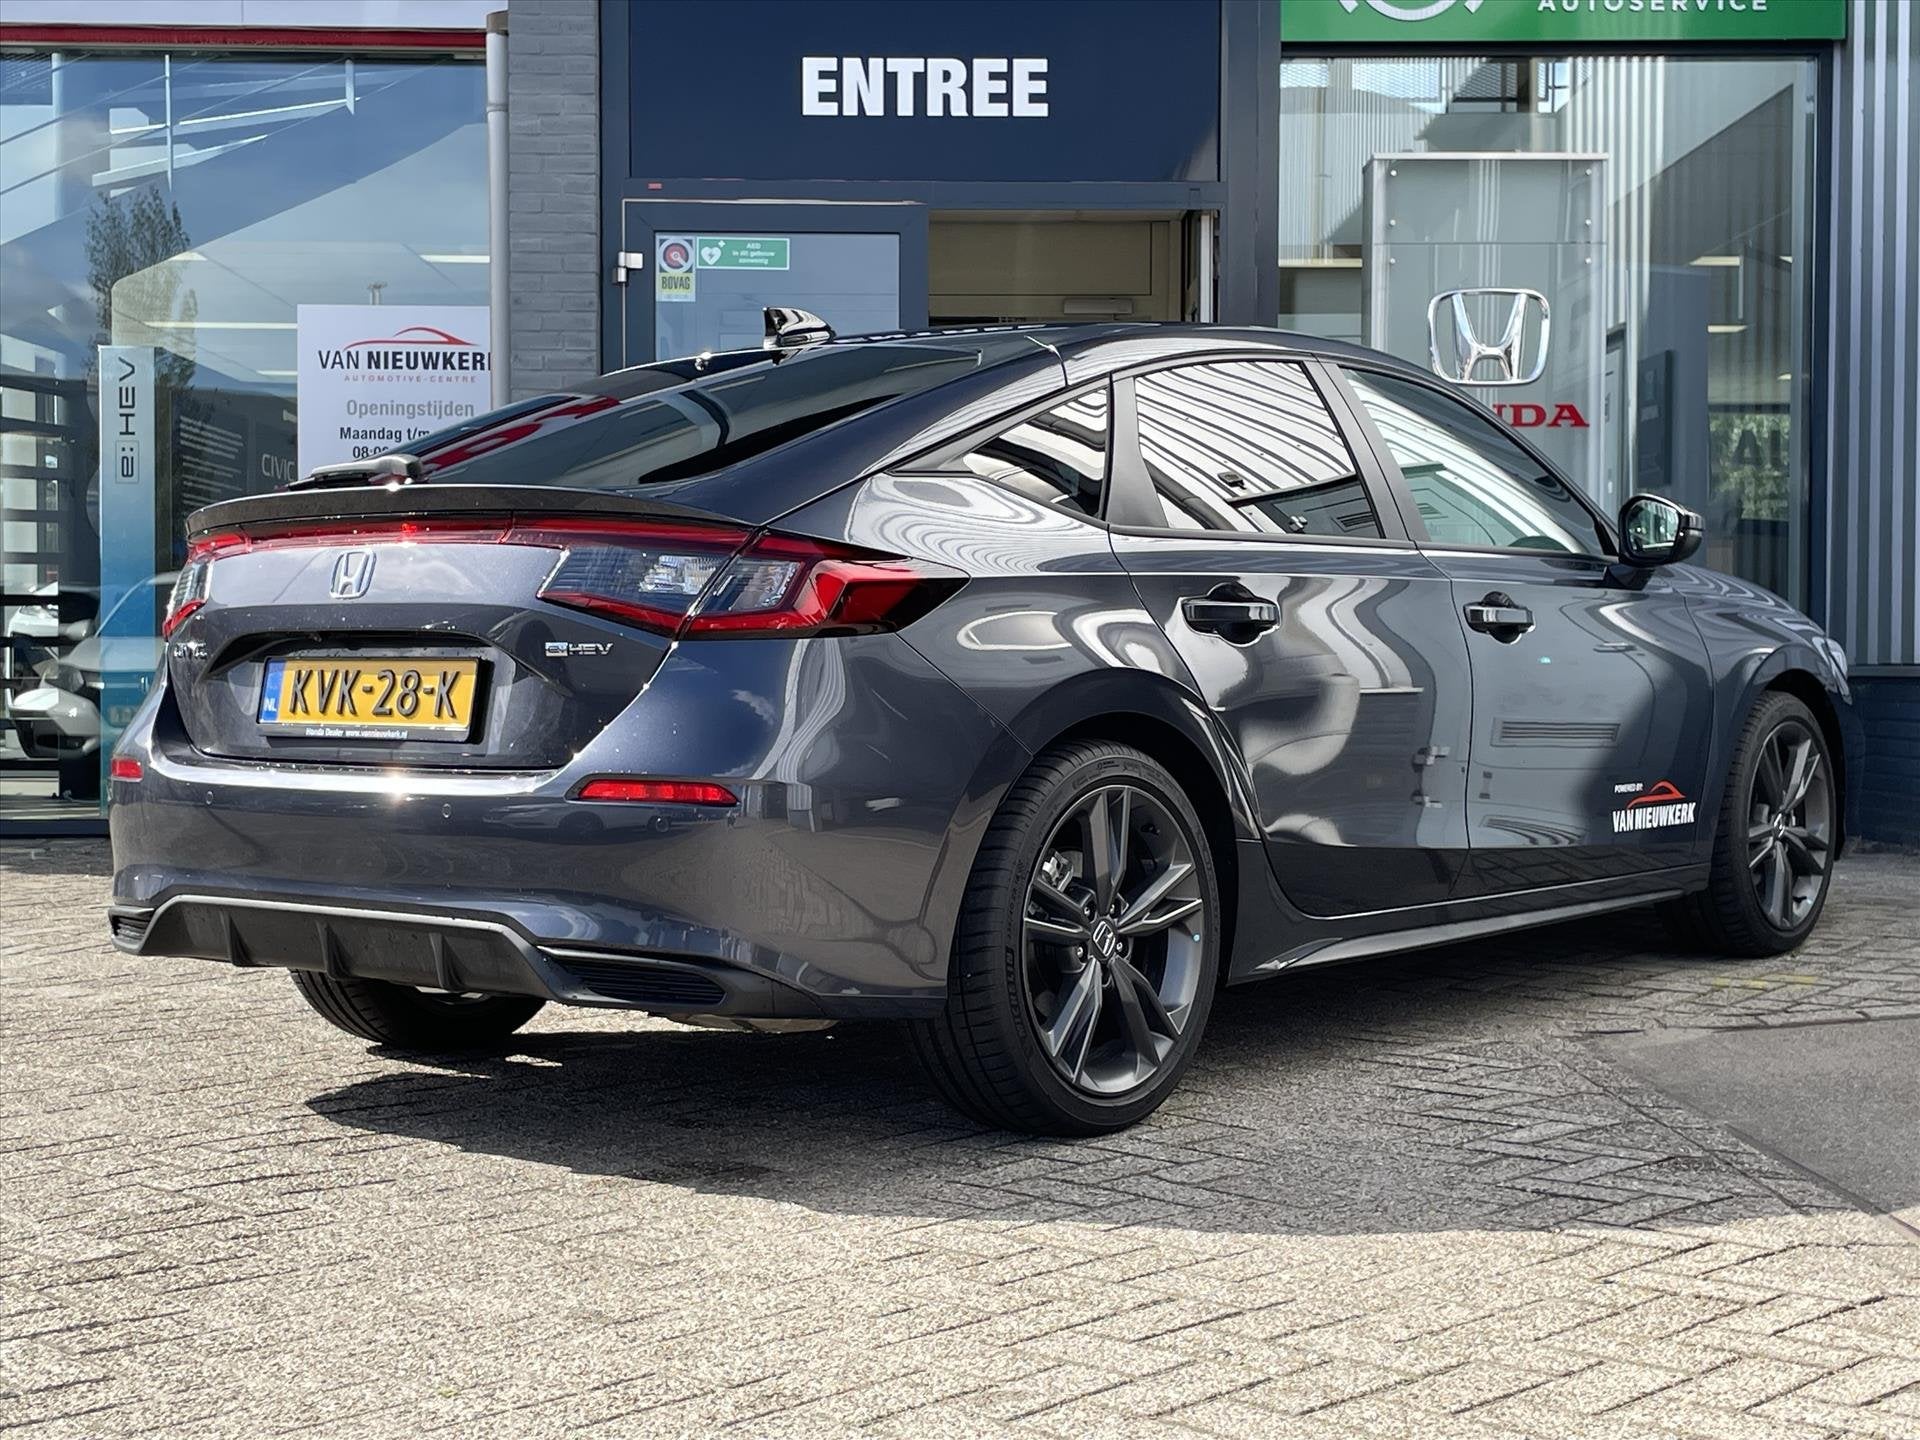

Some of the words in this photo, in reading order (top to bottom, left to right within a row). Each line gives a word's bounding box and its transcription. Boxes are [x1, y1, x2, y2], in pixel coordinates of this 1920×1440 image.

[1537, 0, 1768, 12] AUTOSERVICE
[802, 56, 1049, 118] ENTREE
[661, 276, 691, 290] BOVAG
[318, 350, 360, 370] VAN
[367, 351, 491, 371] NIEUWKER
[346, 400, 475, 420] Openingstijden
[339, 427, 402, 443] Maandag
[261, 453, 296, 483] CIVIC
[263, 697, 277, 711] NL
[288, 669, 461, 719] KVK-28-K
[1612, 809, 1634, 833] VAN
[1635, 802, 1696, 830] NIEUWKERK
